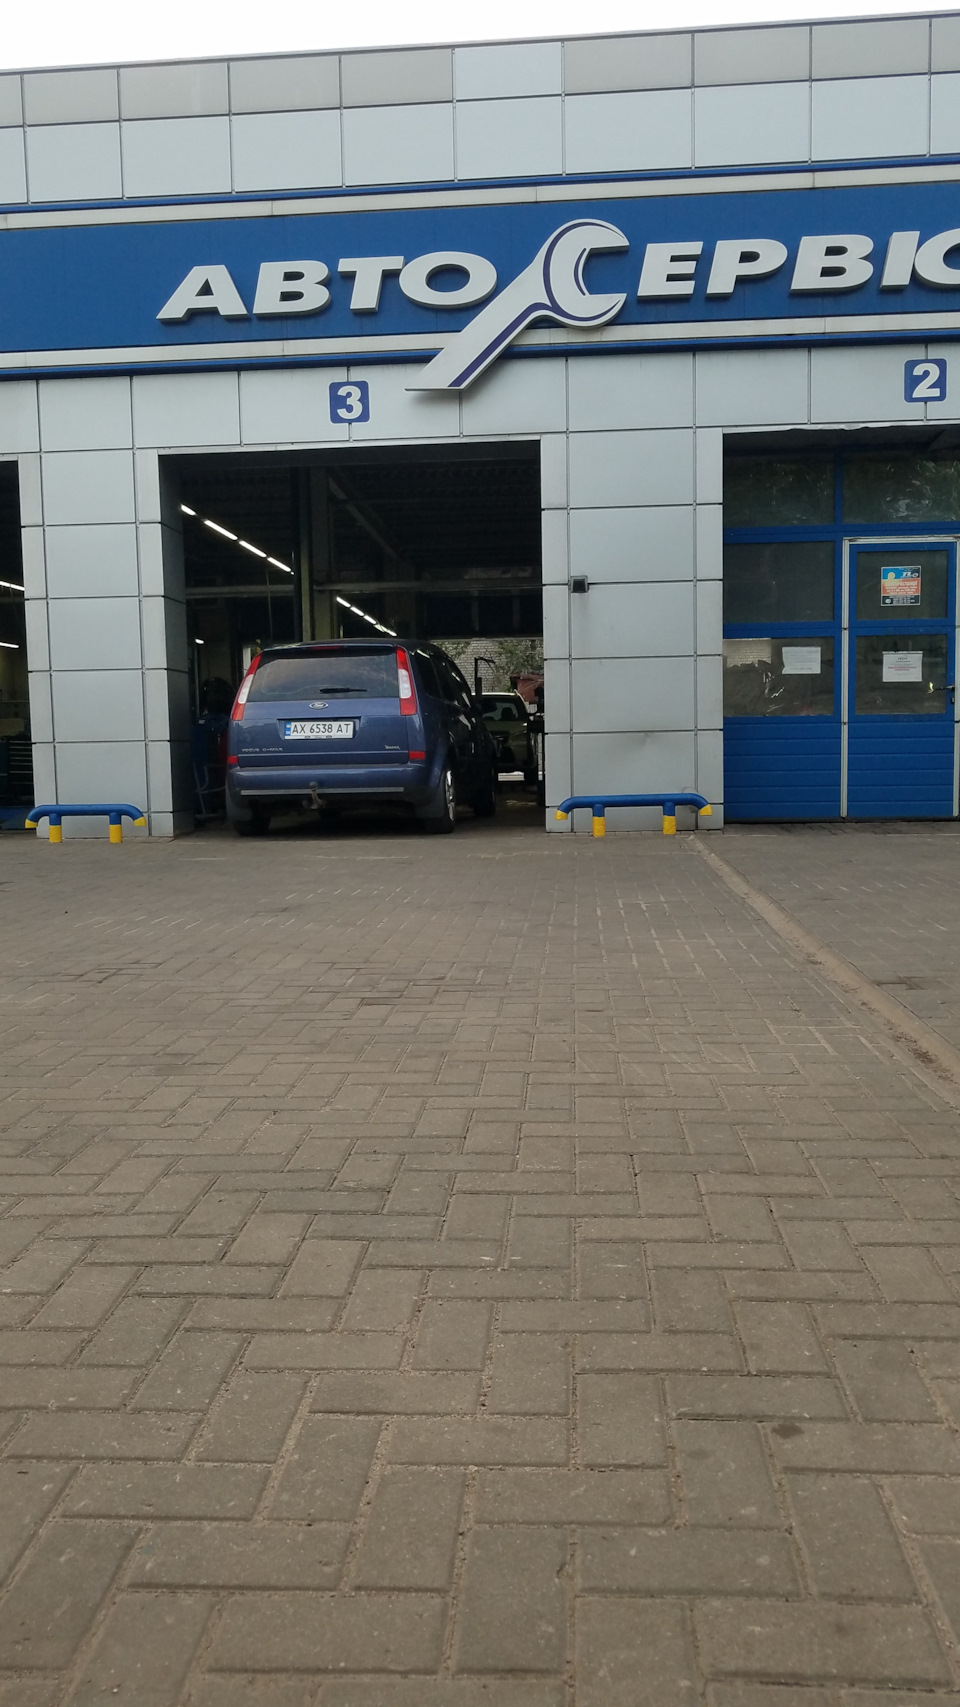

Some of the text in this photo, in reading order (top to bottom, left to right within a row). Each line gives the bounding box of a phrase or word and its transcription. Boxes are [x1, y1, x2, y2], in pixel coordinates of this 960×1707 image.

[911, 362, 941, 399] 2
[336, 385, 364, 420] 3
[291, 723, 307, 735] AX
[309, 723, 333, 734] 6538
[336, 723, 352, 734] AT
